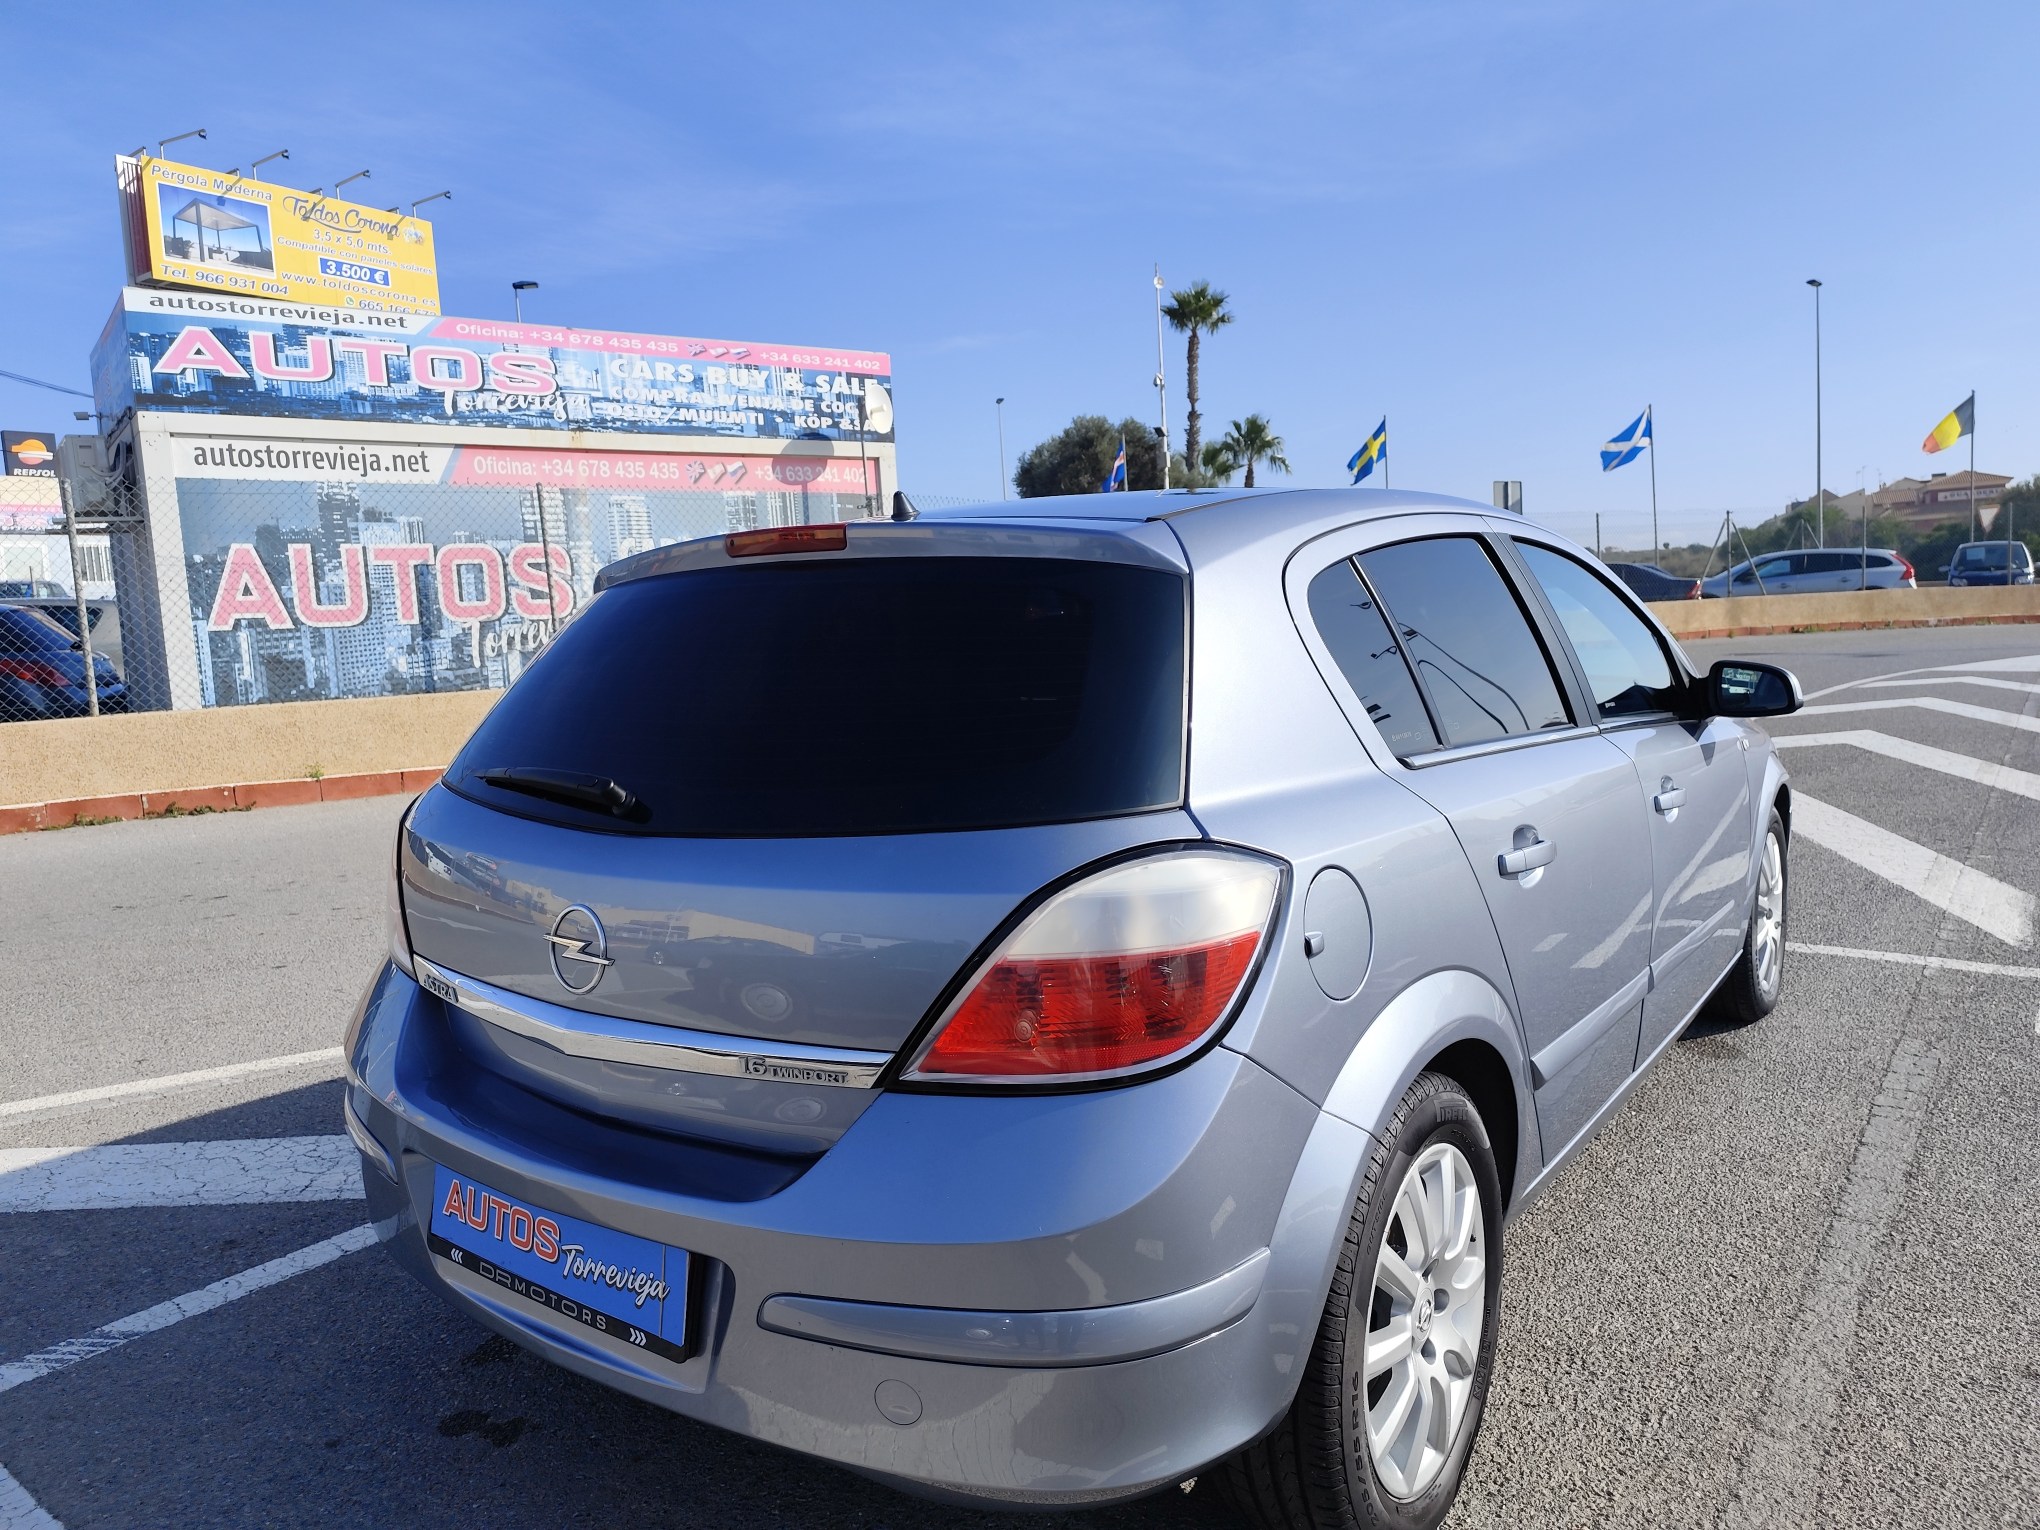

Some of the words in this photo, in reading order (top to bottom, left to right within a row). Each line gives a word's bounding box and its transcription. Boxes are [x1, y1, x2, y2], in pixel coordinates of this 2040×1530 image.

[151, 165, 208, 187] Pérgola
[213, 178, 272, 201] Moderna
[283, 195, 340, 224] Toldos
[344, 209, 400, 237] Corona
[277, 236, 337, 255] Compatible
[339, 251, 358, 259] con
[360, 255, 398, 268] paneles
[400, 263, 433, 275] solares
[313, 229, 332, 242] 3,5
[346, 237, 364, 249] 5,0
[367, 242, 392, 255] mts.
[160, 264, 190, 279] Tel.
[195, 271, 225, 284] 966
[229, 276, 257, 290] 931
[261, 282, 289, 295] 004
[326, 261, 371, 281] 3.500
[373, 271, 385, 284] €
[281, 271, 436, 307] www.toldoscorona.es
[149, 293, 408, 330] autostorrevieja.net
[358, 299, 387, 312] 665
[455, 323, 524, 340] Oficina:
[529, 331, 565, 343] +34
[569, 334, 604, 347] 678
[608, 338, 642, 350] 435
[646, 341, 679, 353] 435
[152, 325, 557, 397] AUTOS
[610, 358, 695, 384] CARS
[706, 366, 769, 390] BUY
[783, 373, 805, 393] &
[760, 351, 789, 363] +34
[792, 354, 821, 366] 633
[824, 357, 851, 368] 241
[854, 359, 880, 370] 402
[791, 398, 815, 412] DE
[794, 413, 833, 429] KÖP
[13, 468, 56, 477] REPSOL
[194, 443, 430, 478] autostorrevieja.net
[473, 455, 537, 476] Oficina:
[541, 461, 575, 476] +34
[578, 459, 610, 477] 678
[614, 461, 645, 479] 435
[649, 462, 679, 480] 435
[754, 466, 783, 482] +34
[786, 466, 813, 482] 633
[815, 468, 840, 482] 241
[843, 469, 865, 483] 402
[207, 542, 577, 632] AUTOS
[423, 973, 459, 1003] ASTRA
[768, 1064, 848, 1084] TWINPORT
[442, 1178, 560, 1264] AUTOS
[561, 1244, 670, 1306] Torrevieja
[1350, 1370, 1360, 1431] R16
